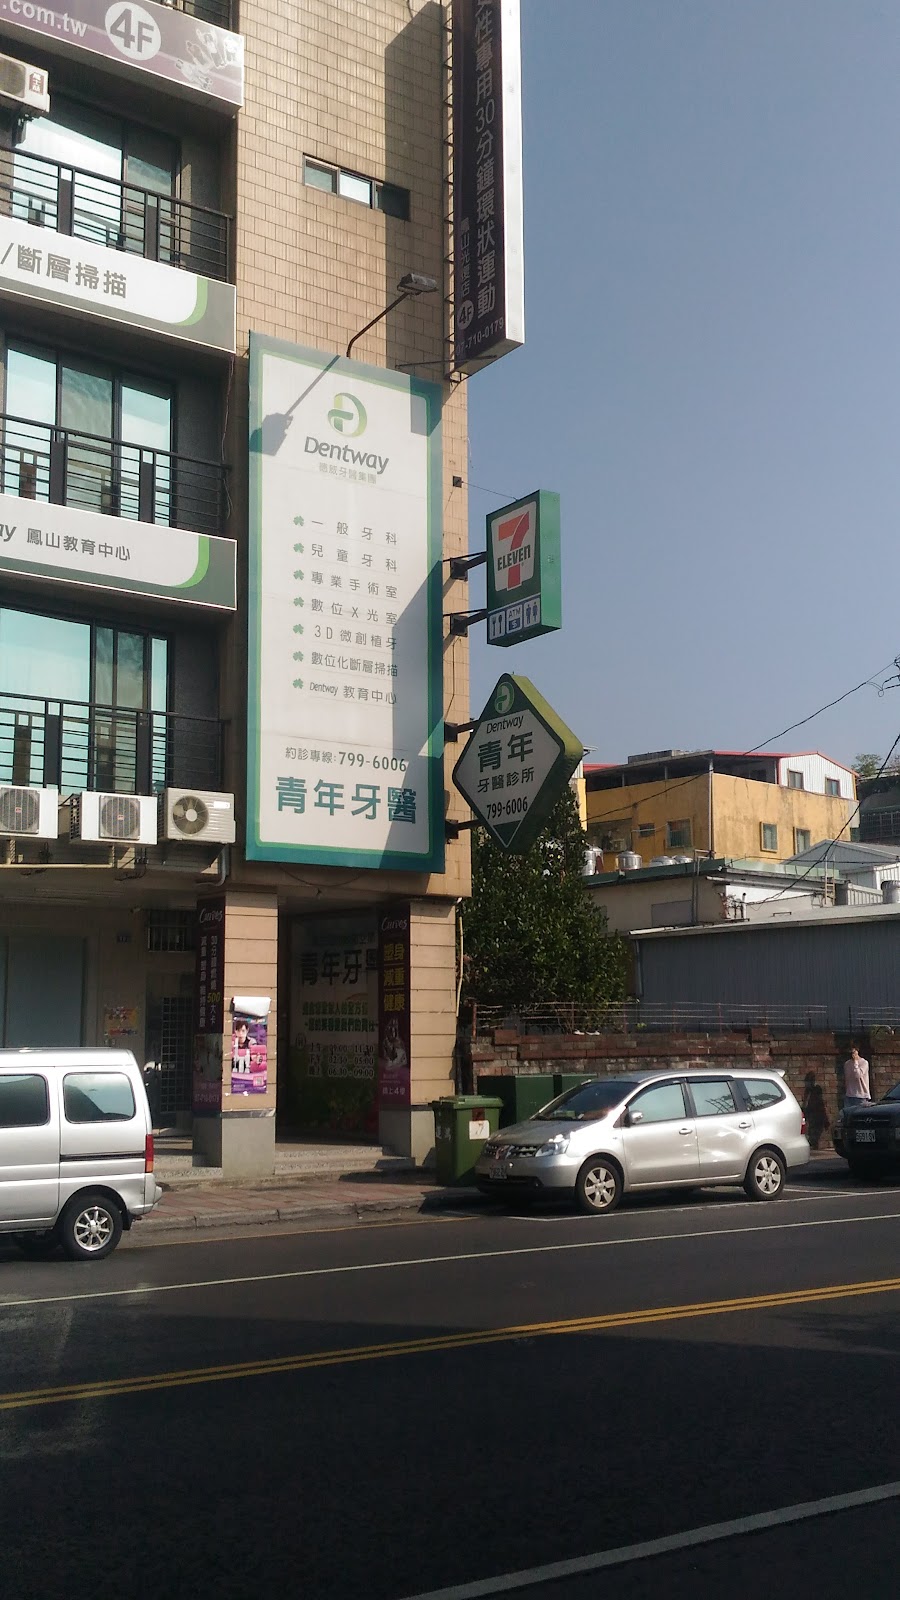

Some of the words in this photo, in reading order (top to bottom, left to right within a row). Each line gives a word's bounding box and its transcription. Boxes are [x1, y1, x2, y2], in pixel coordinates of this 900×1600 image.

[109, 8, 155, 53] 4F
[458, 304, 474, 325] 4F
[456, 317, 504, 356] 07-710-0179
[304, 436, 390, 475] Dentway
[26, 528, 131, 561] 鳳山教育中心
[311, 520, 397, 546] 一般牙科
[311, 543, 397, 573] 兒童牙科
[311, 571, 398, 599] 專業手術室
[508, 607, 521, 618] ATM
[311, 651, 398, 677] 數位化斷層掃描
[309, 682, 338, 697] Dentway
[343, 685, 397, 705] 教育中心
[486, 715, 525, 734] Dentway
[477, 731, 534, 773] 青年
[477, 767, 535, 794] 牙醫診所
[275, 776, 417, 825] 青年牙醫
[486, 796, 528, 820] 799-6006
